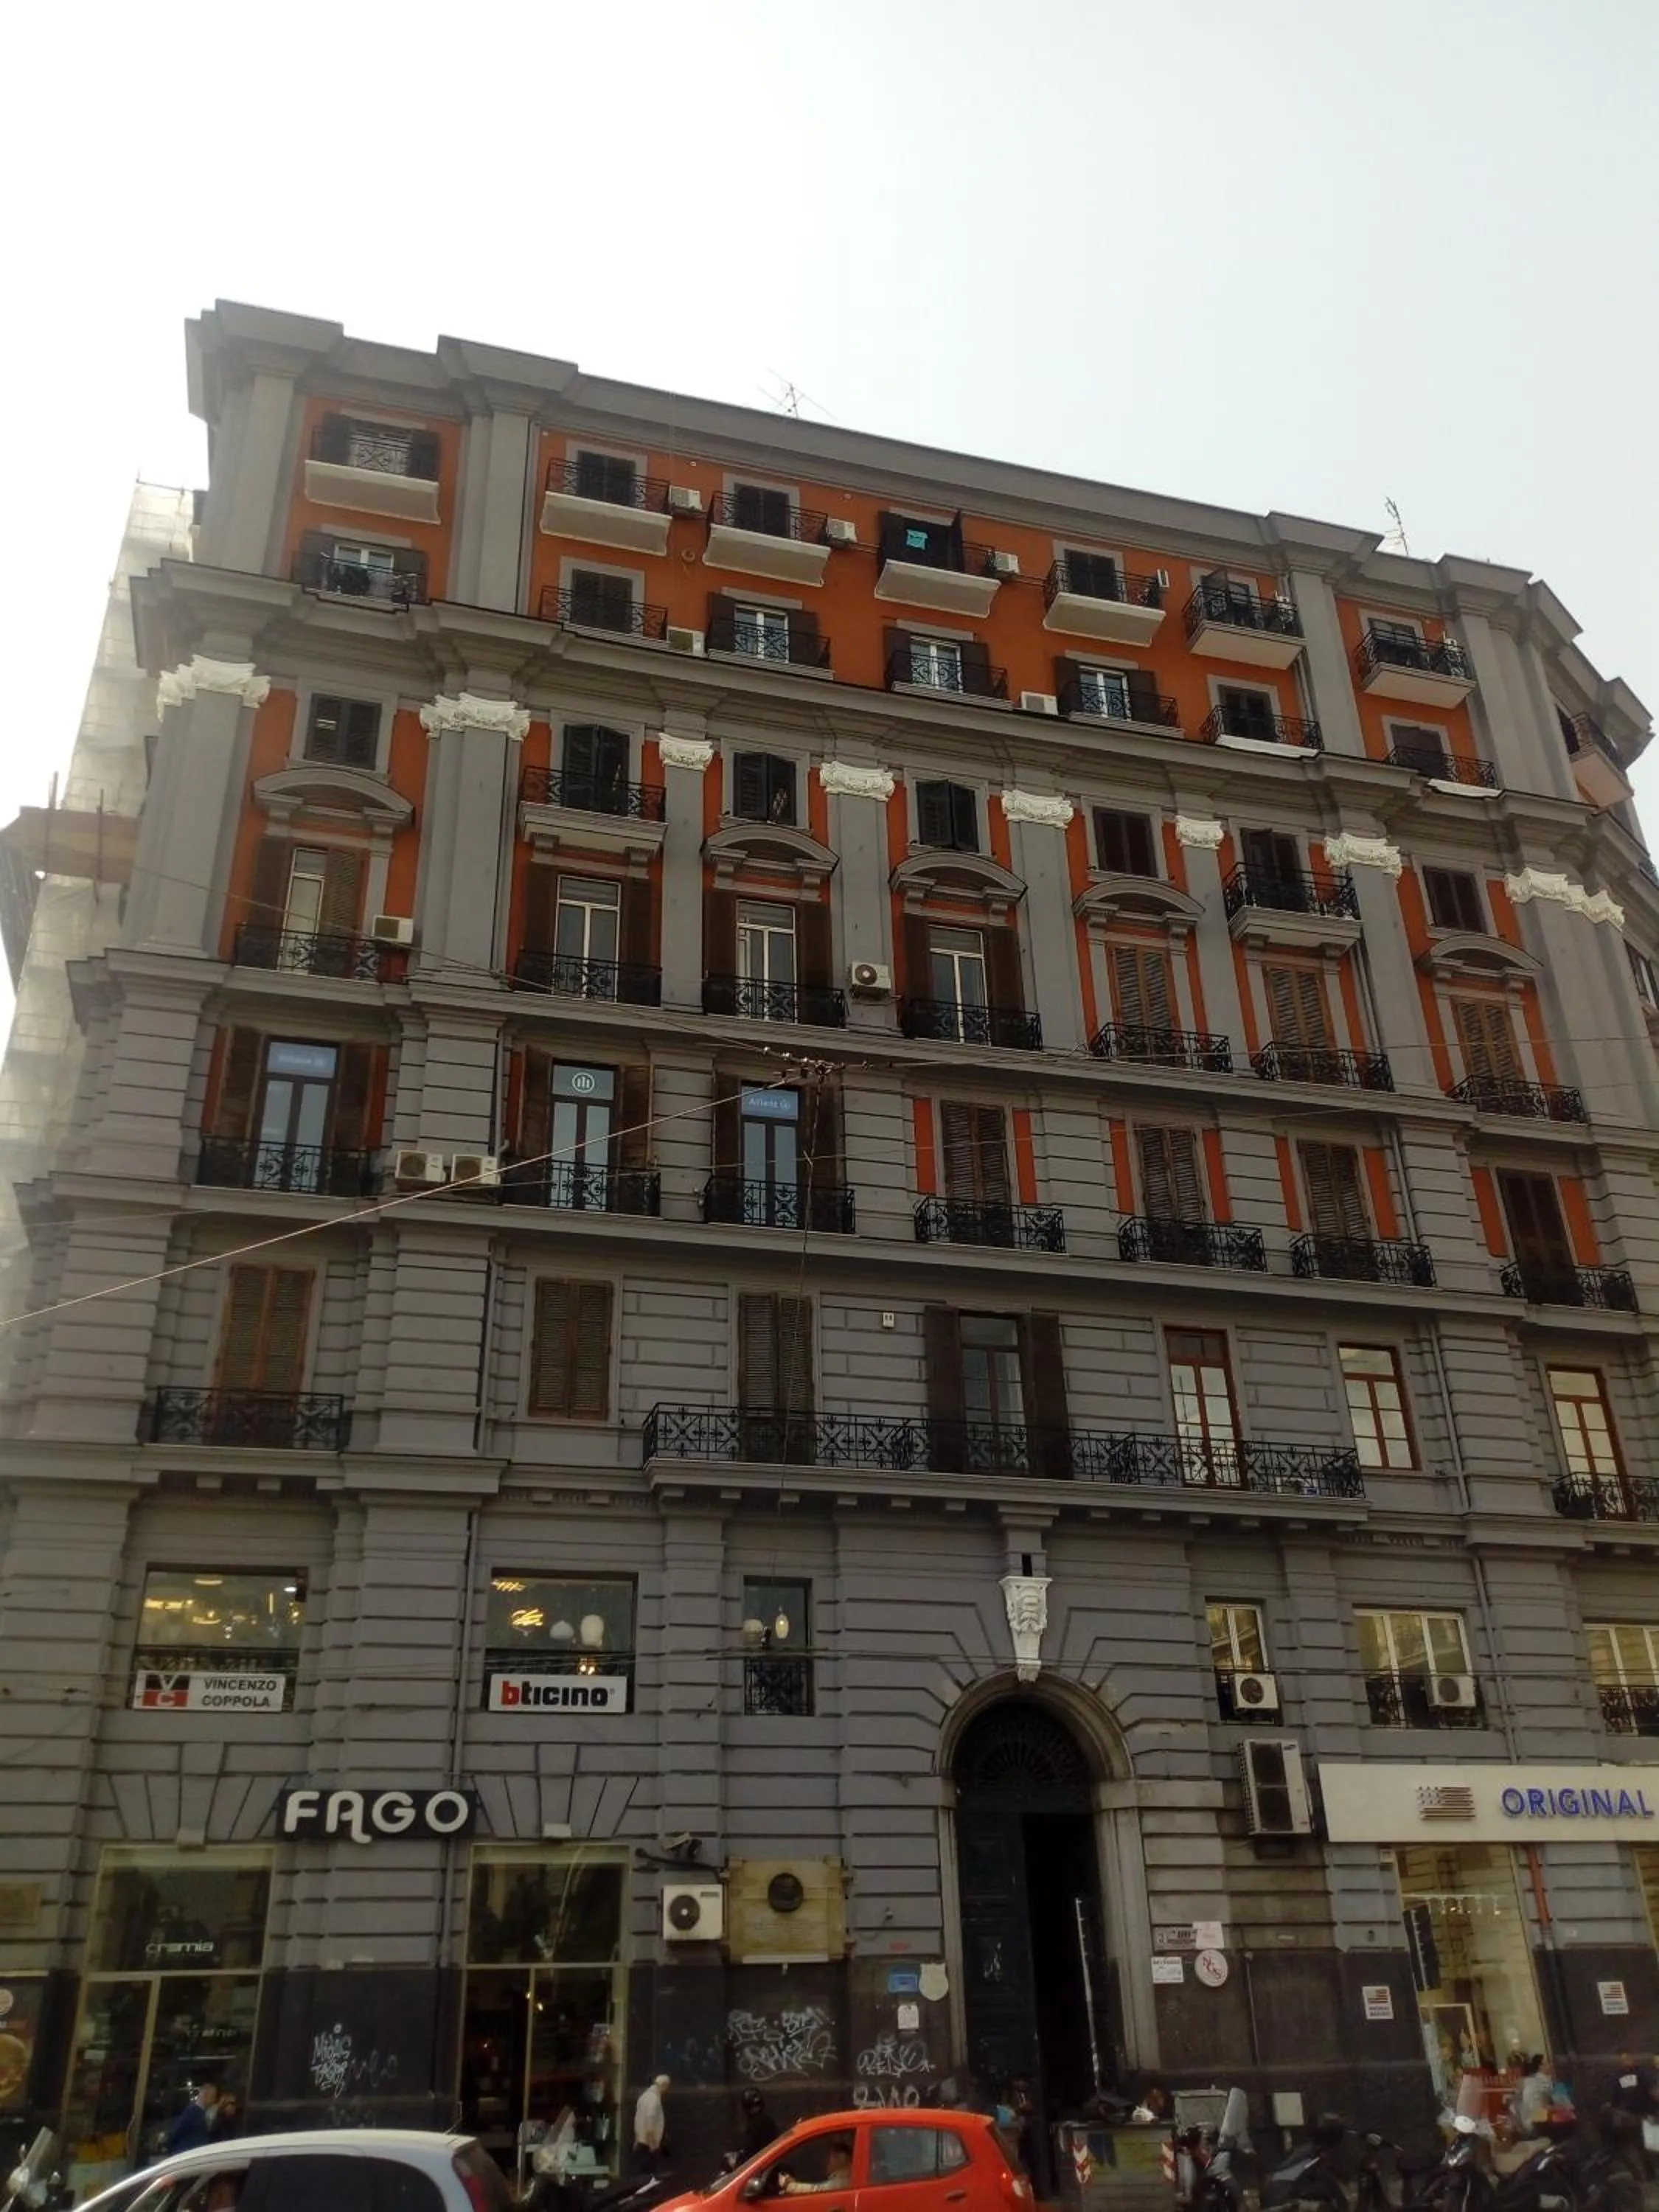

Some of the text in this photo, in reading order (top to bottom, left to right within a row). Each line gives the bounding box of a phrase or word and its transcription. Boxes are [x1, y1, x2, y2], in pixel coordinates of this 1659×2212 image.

[203, 1677, 277, 1691] VINCENZO
[501, 1680, 608, 1707] bticino
[201, 1694, 270, 1707] COPPOLA
[283, 1790, 468, 1843] FAGO
[1501, 1787, 1655, 1819] ORIGINAL
